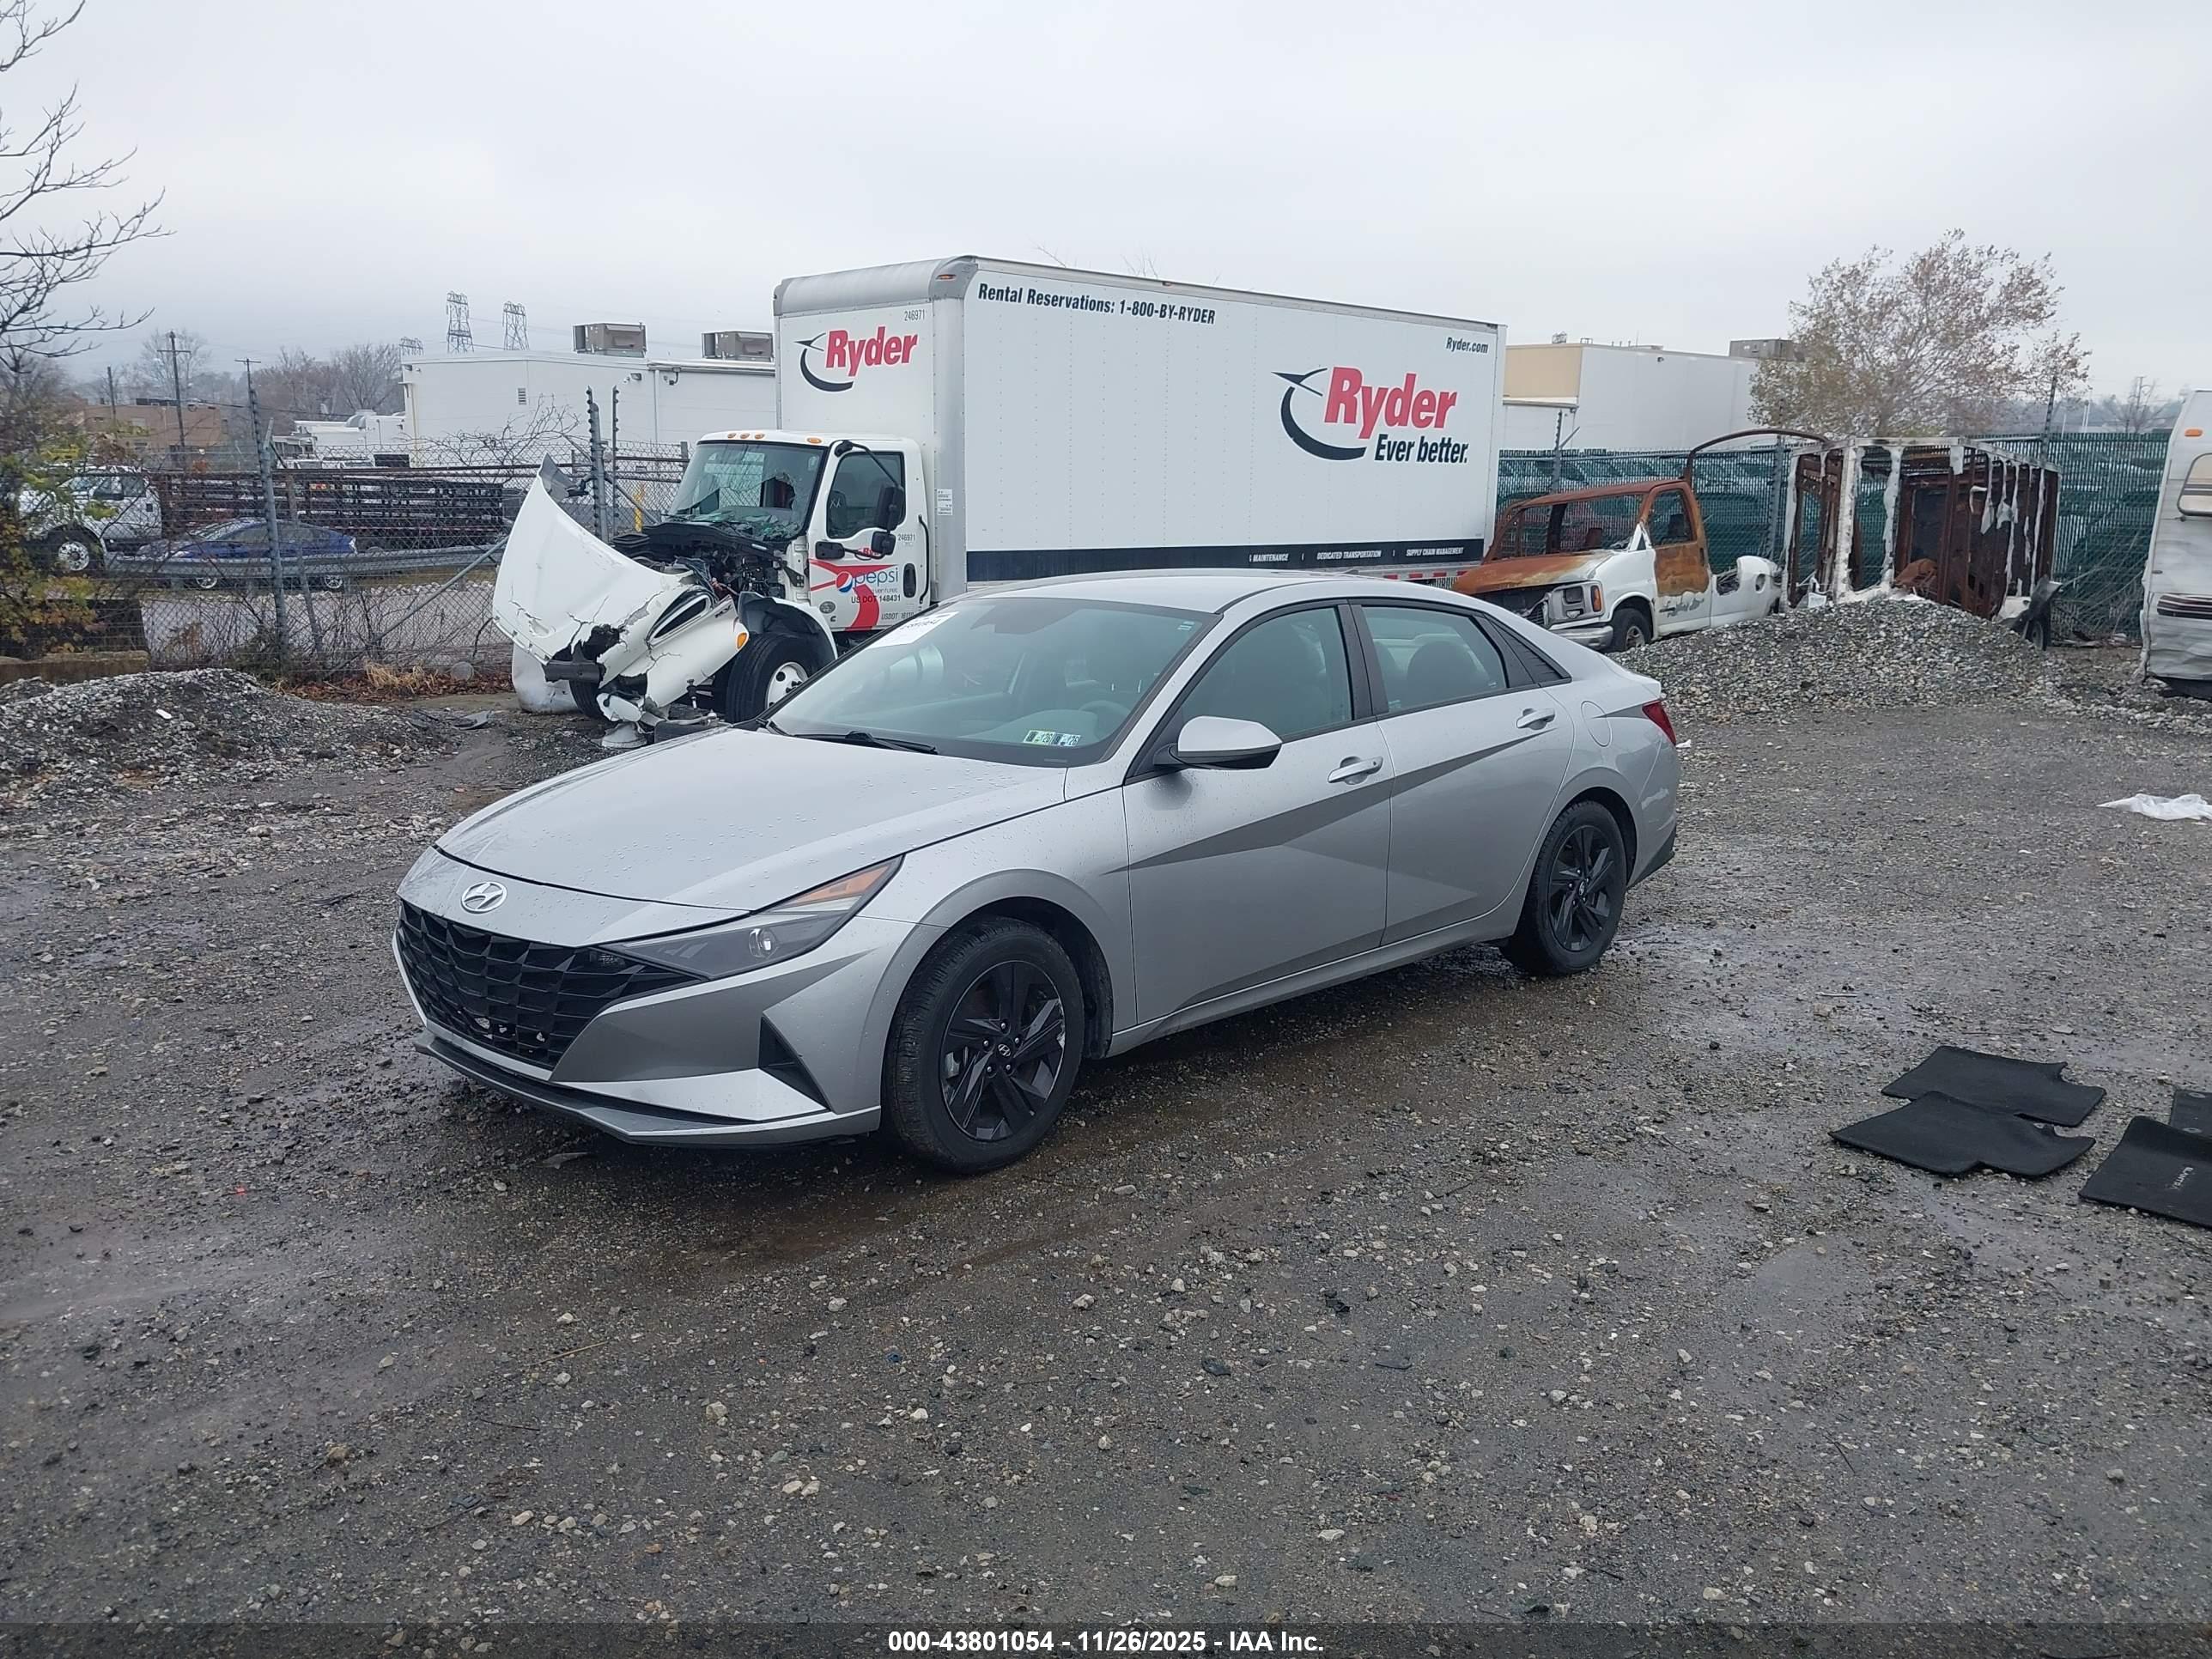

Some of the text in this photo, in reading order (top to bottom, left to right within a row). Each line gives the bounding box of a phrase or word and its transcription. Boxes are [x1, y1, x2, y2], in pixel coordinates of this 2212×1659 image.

[978, 283, 1216, 325] Rental Reservations: 1-800-BY-RYDER
[904, 309, 925, 321] 246971
[826, 325, 918, 377] Ryder
[1445, 337, 1489, 354] Ryder.com
[1324, 366, 1458, 440] Ryder
[1374, 434, 1469, 464] Ever better.
[1252, 553, 1289, 562] MAINTENANCE
[1316, 550, 1382, 560] DEDICATED TRANSPORTATION
[1406, 548, 1422, 556] SUPPLY
[854, 567, 898, 588] pepsi
[862, 594, 878, 603] DOT
[879, 594, 901, 603] 148431
